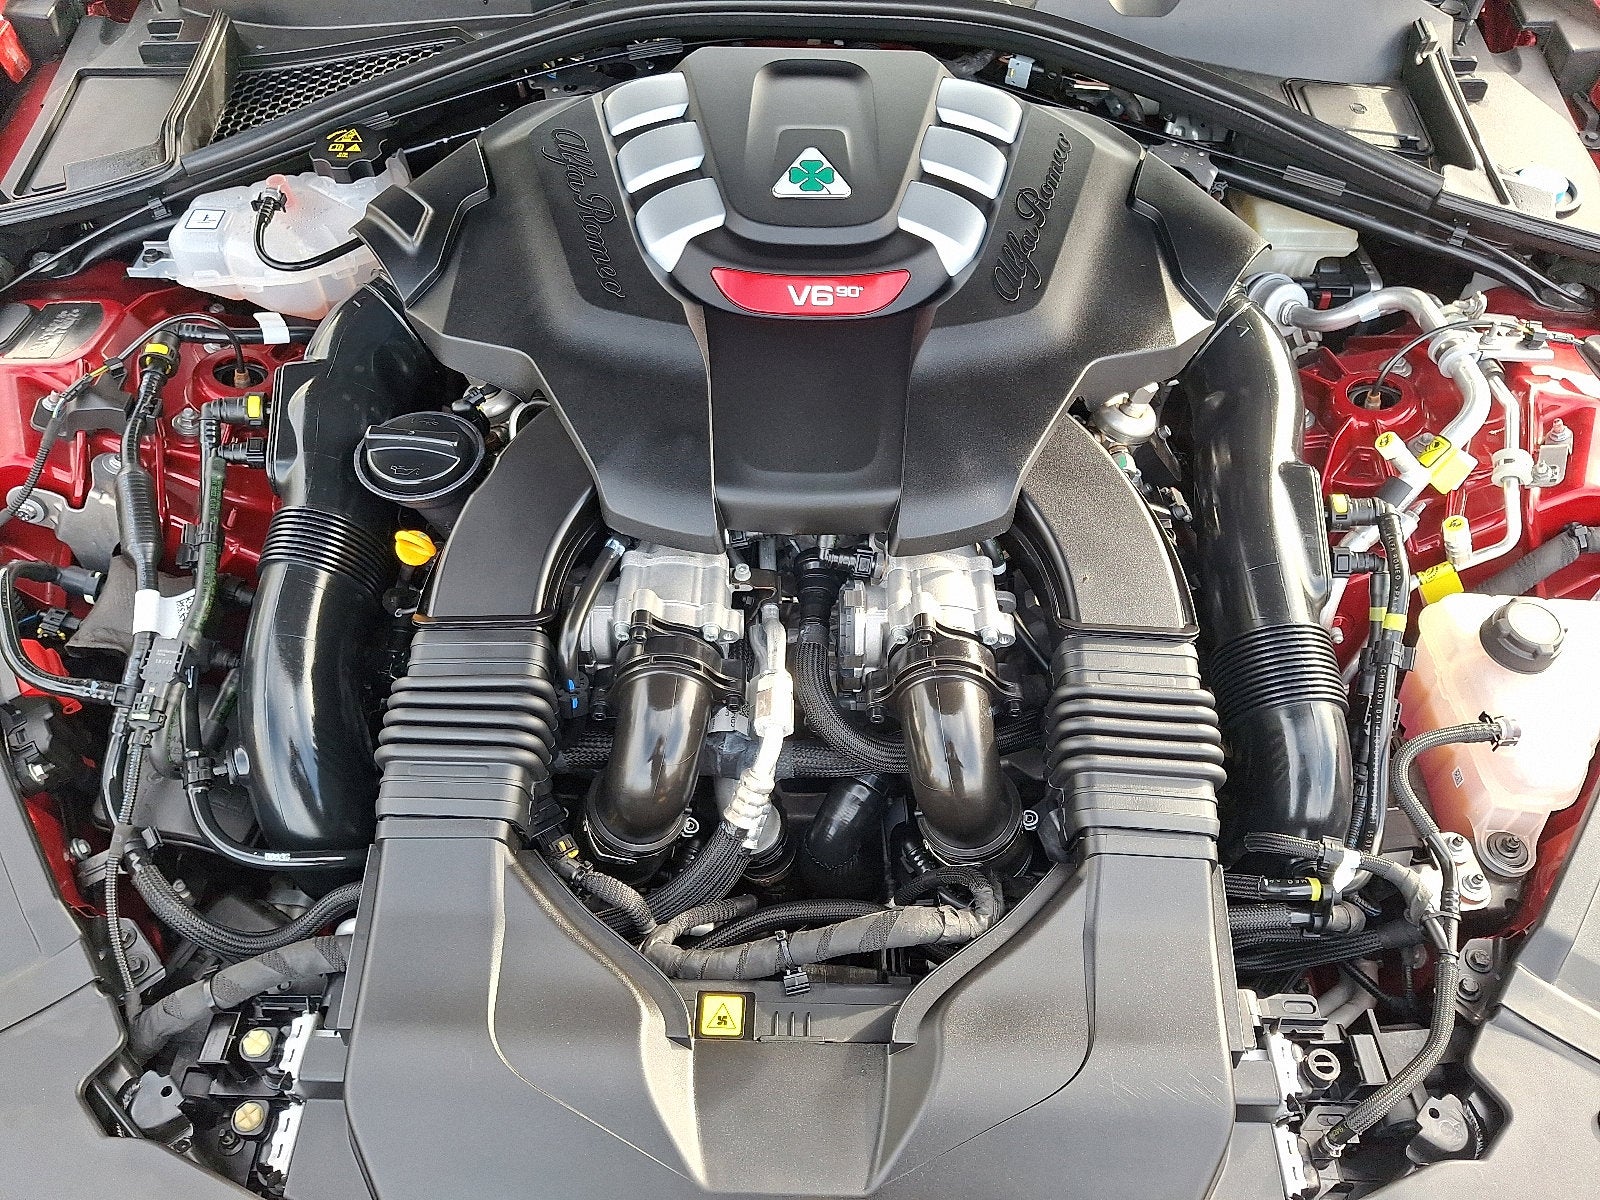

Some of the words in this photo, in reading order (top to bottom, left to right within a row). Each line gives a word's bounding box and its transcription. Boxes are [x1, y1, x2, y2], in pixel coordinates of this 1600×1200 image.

[541, 128, 598, 195] Alfa
[573, 193, 626, 298] Romeo
[1015, 132, 1073, 228] Romeo
[787, 285, 834, 306] V6
[994, 225, 1042, 302] Alfa
[1377, 664, 1387, 705] TCHINSON
